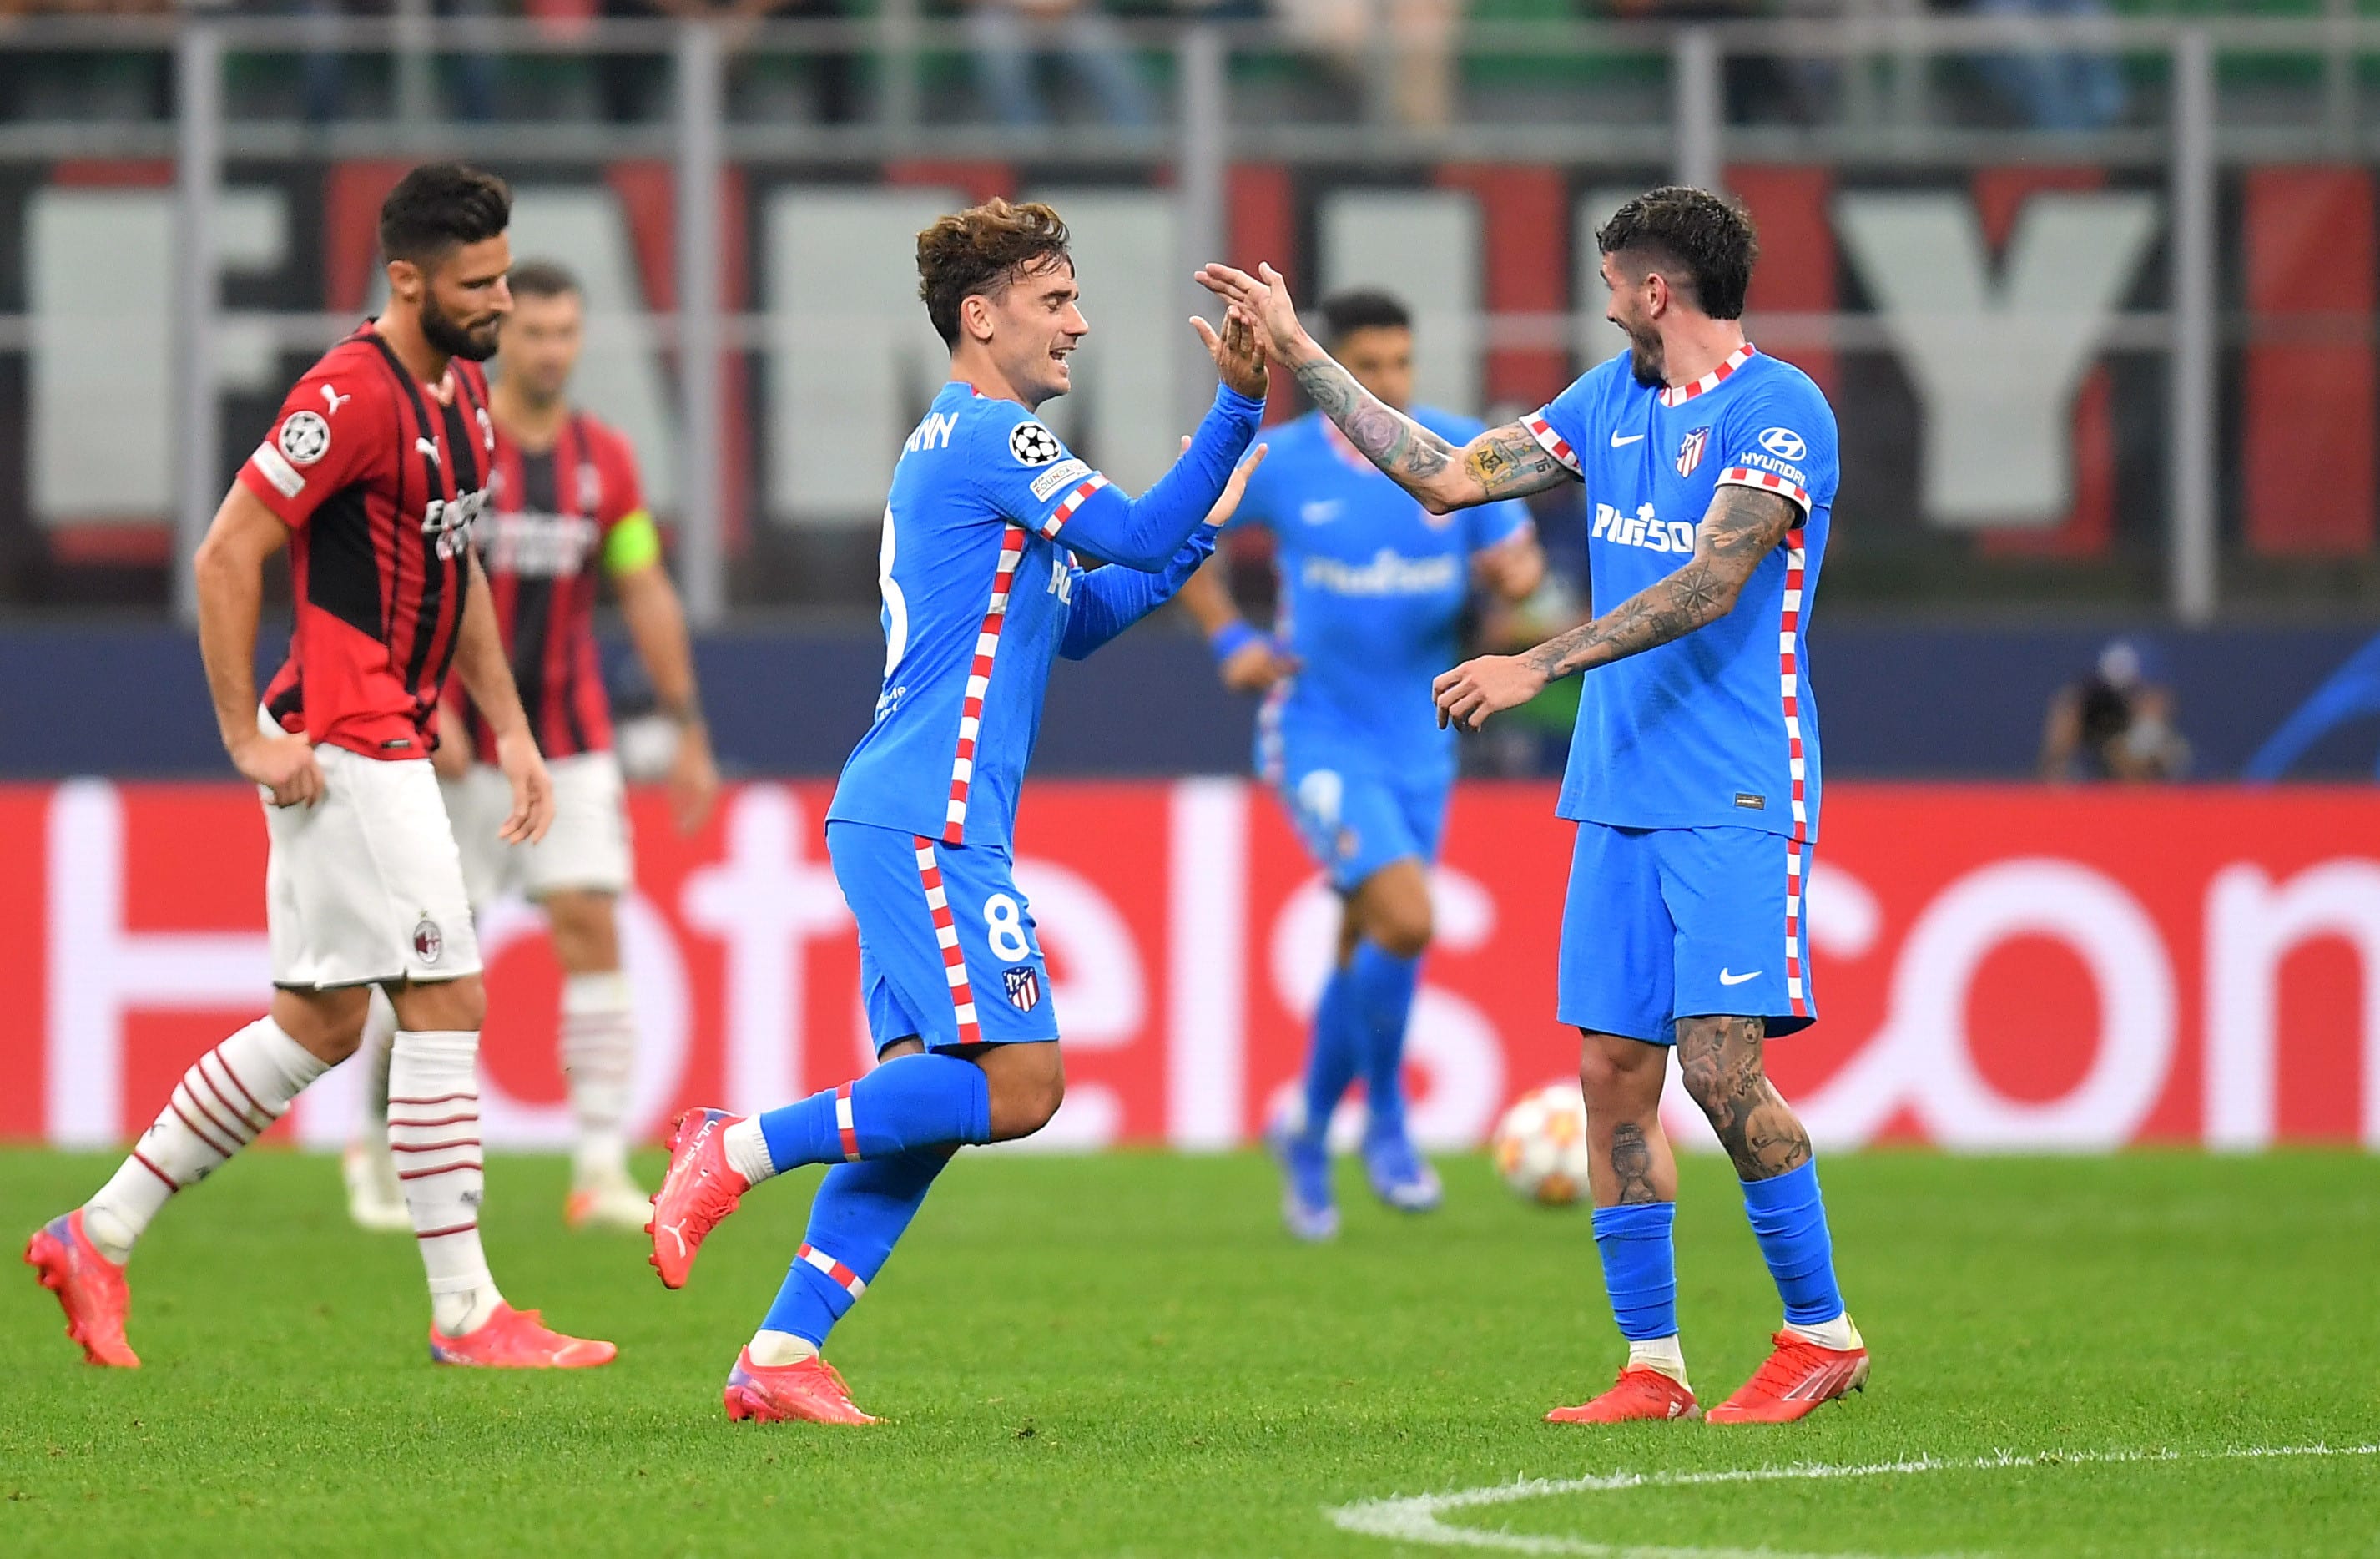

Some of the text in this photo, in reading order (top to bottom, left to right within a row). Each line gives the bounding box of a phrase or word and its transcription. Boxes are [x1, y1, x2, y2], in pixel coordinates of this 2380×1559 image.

[28, 185, 2161, 527] FAMIY
[1740, 451, 1807, 485] HYUNDAI
[1591, 501, 1699, 553] Plus50
[983, 892, 1030, 962] 8
[46, 778, 2380, 1152] Hotelsco
[673, 1119, 719, 1173] ULTRA
